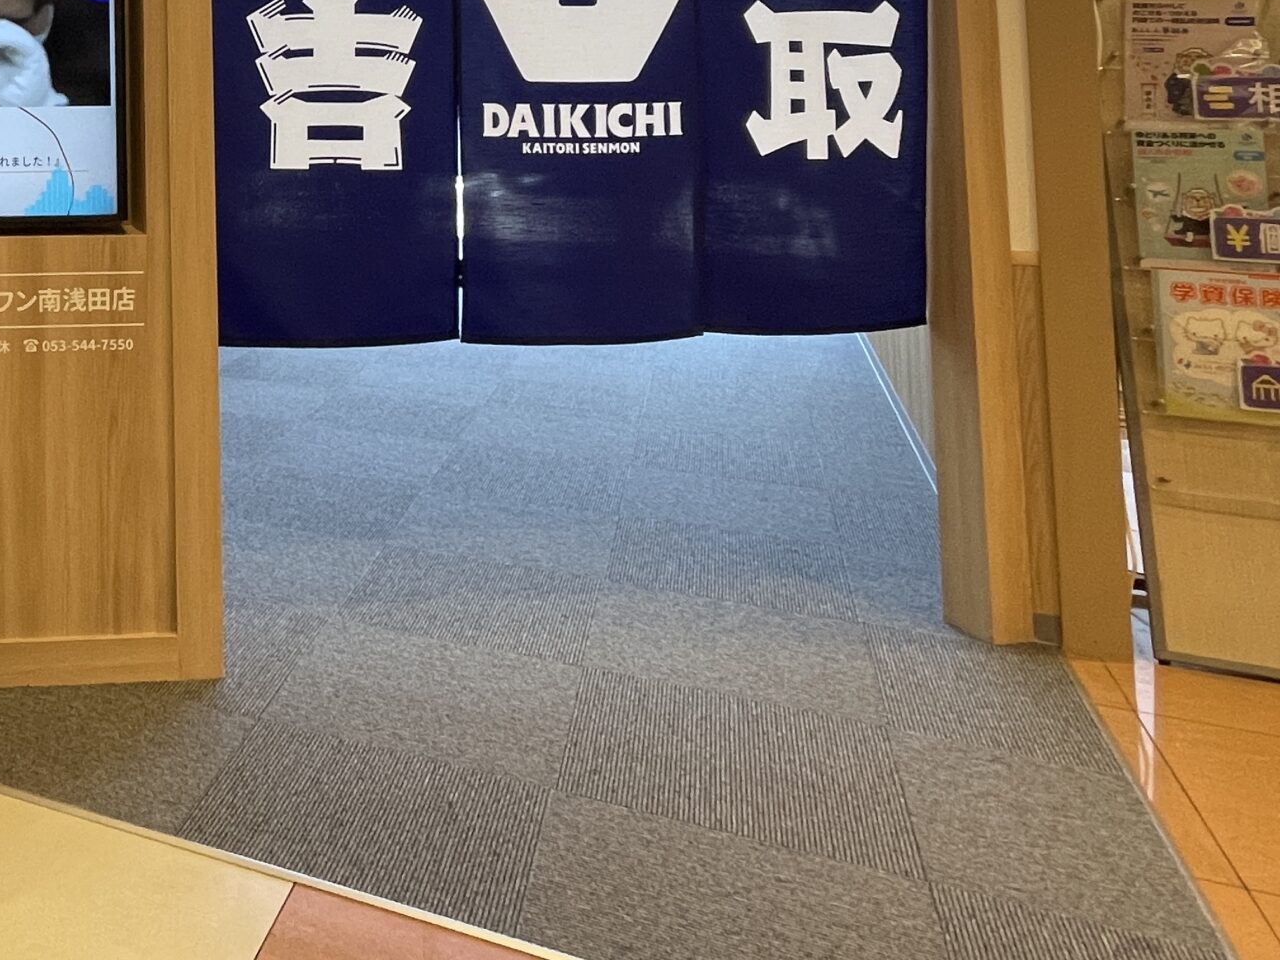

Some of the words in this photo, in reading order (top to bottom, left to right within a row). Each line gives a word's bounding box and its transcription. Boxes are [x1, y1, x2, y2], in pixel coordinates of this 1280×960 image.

[482, 102, 683, 138] DAIKICHI
[522, 142, 579, 154] KAITORI
[582, 142, 641, 154] SENMON
[42, 338, 134, 352] 053-544-7550
